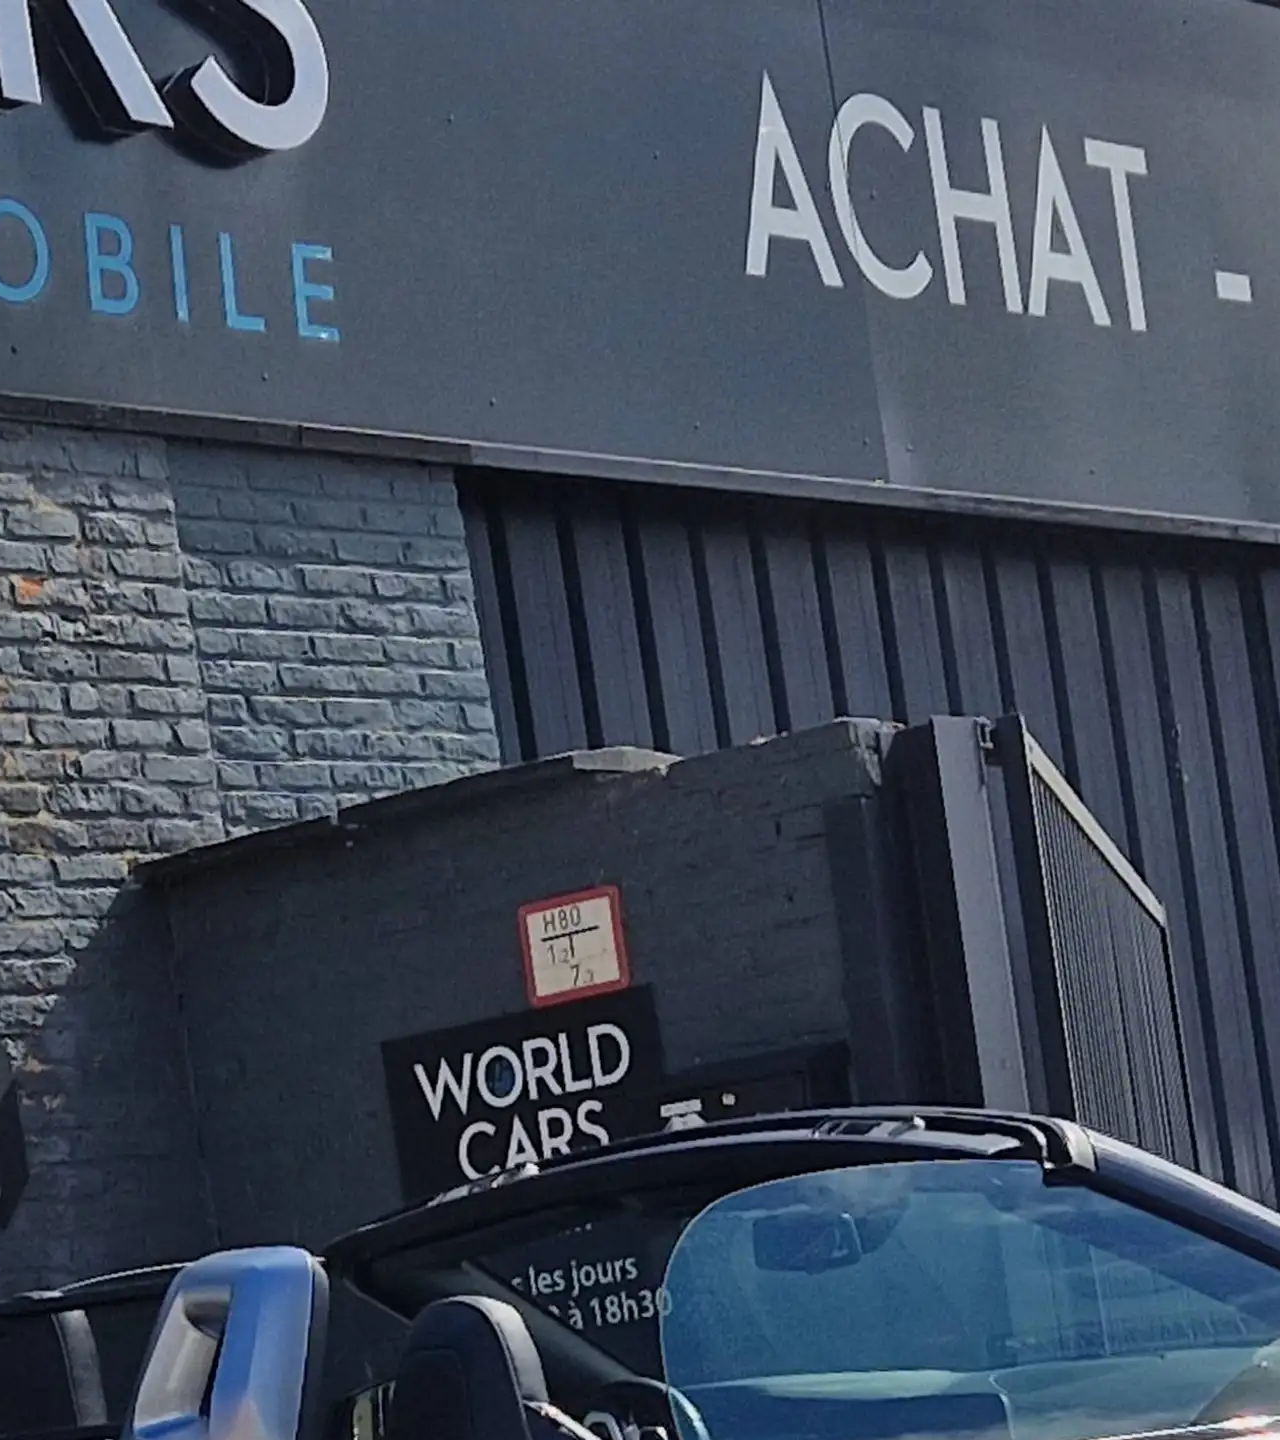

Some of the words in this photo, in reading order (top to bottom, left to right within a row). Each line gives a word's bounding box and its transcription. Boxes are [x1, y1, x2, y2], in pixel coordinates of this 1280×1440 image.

[745, 69, 1148, 332] ACHAT
[412, 1022, 631, 1122] WORLD
[458, 1099, 610, 1181] CARS
[528, 1264, 566, 1297] les
[570, 1257, 638, 1298] jours
[588, 1286, 673, 1327] 18h30
